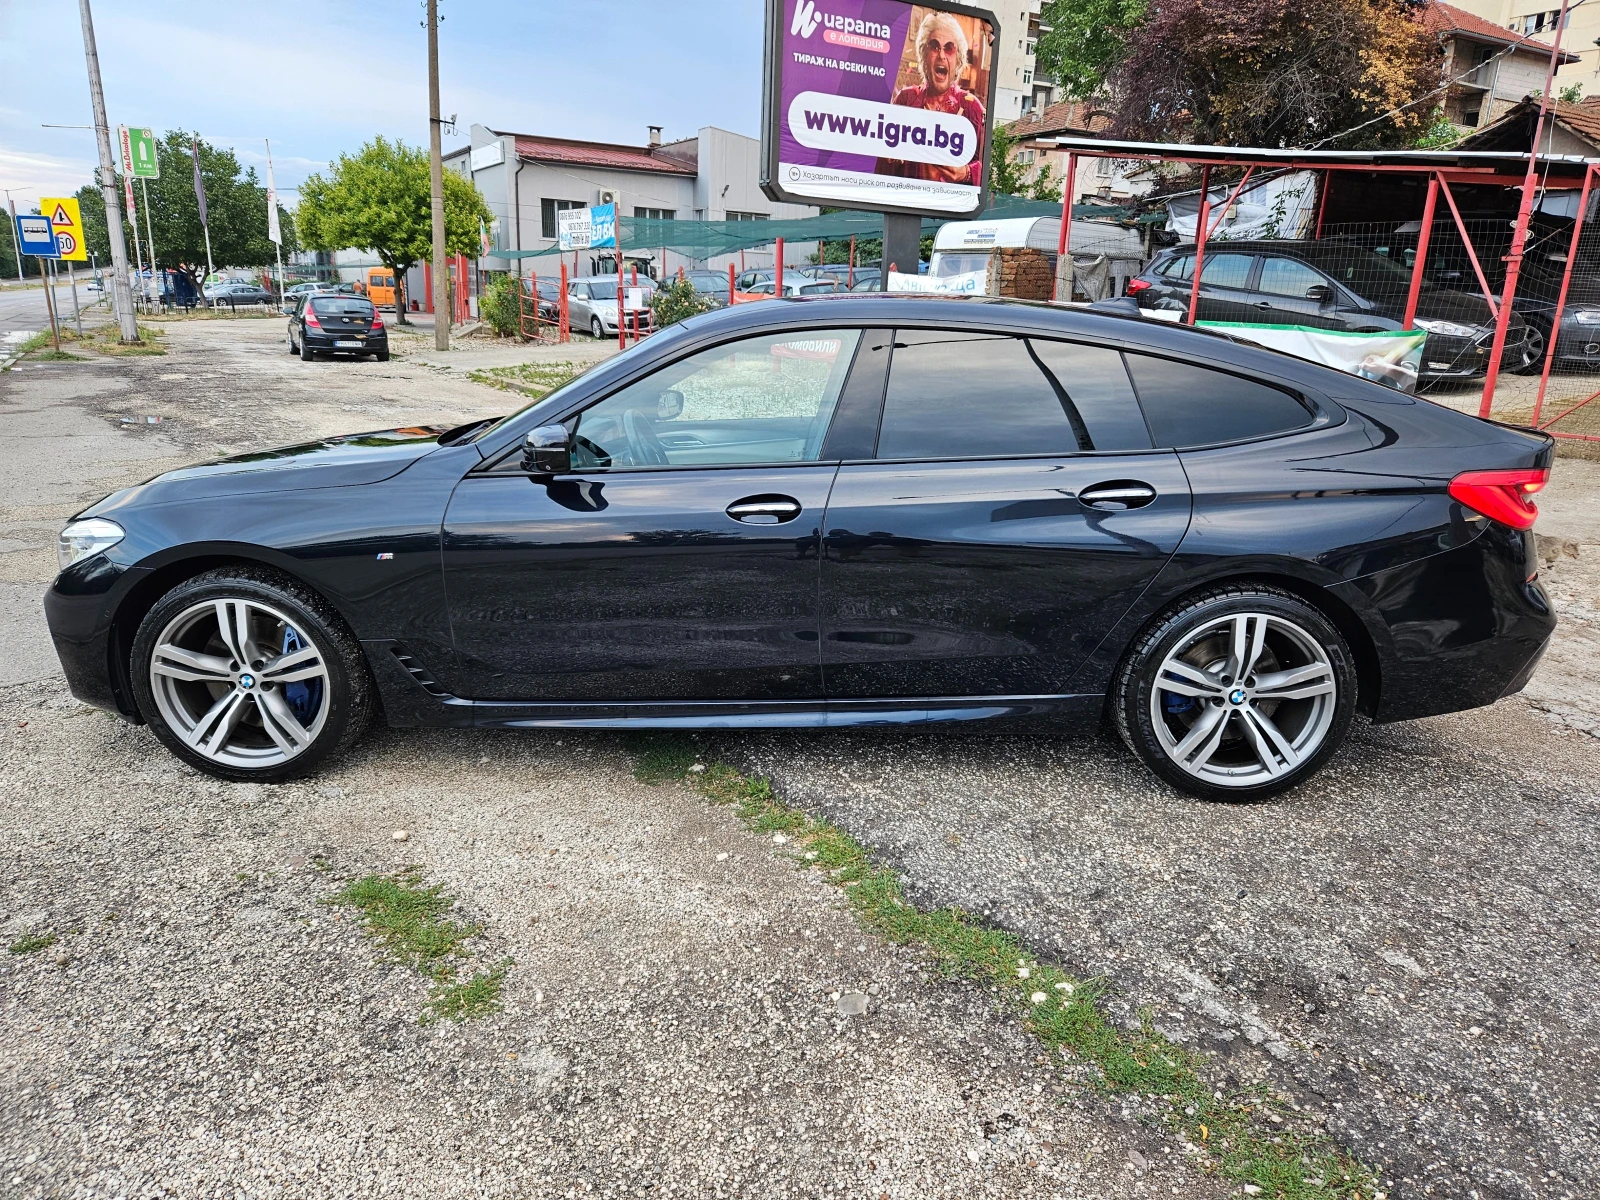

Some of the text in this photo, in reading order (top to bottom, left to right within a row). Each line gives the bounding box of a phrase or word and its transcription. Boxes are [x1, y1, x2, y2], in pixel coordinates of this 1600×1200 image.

[823, 10, 891, 39] играта
[840, 34, 884, 50] лотария
[793, 52, 886, 77] ТИРАЖ НА ВСЕКИ ЧАС
[803, 109, 965, 157] www.igra.bg
[802, 170, 840, 183] Хазартът
[841, 176, 858, 186] носи
[858, 177, 875, 188] риск
[876, 181, 886, 189] от
[886, 181, 922, 194] развиване
